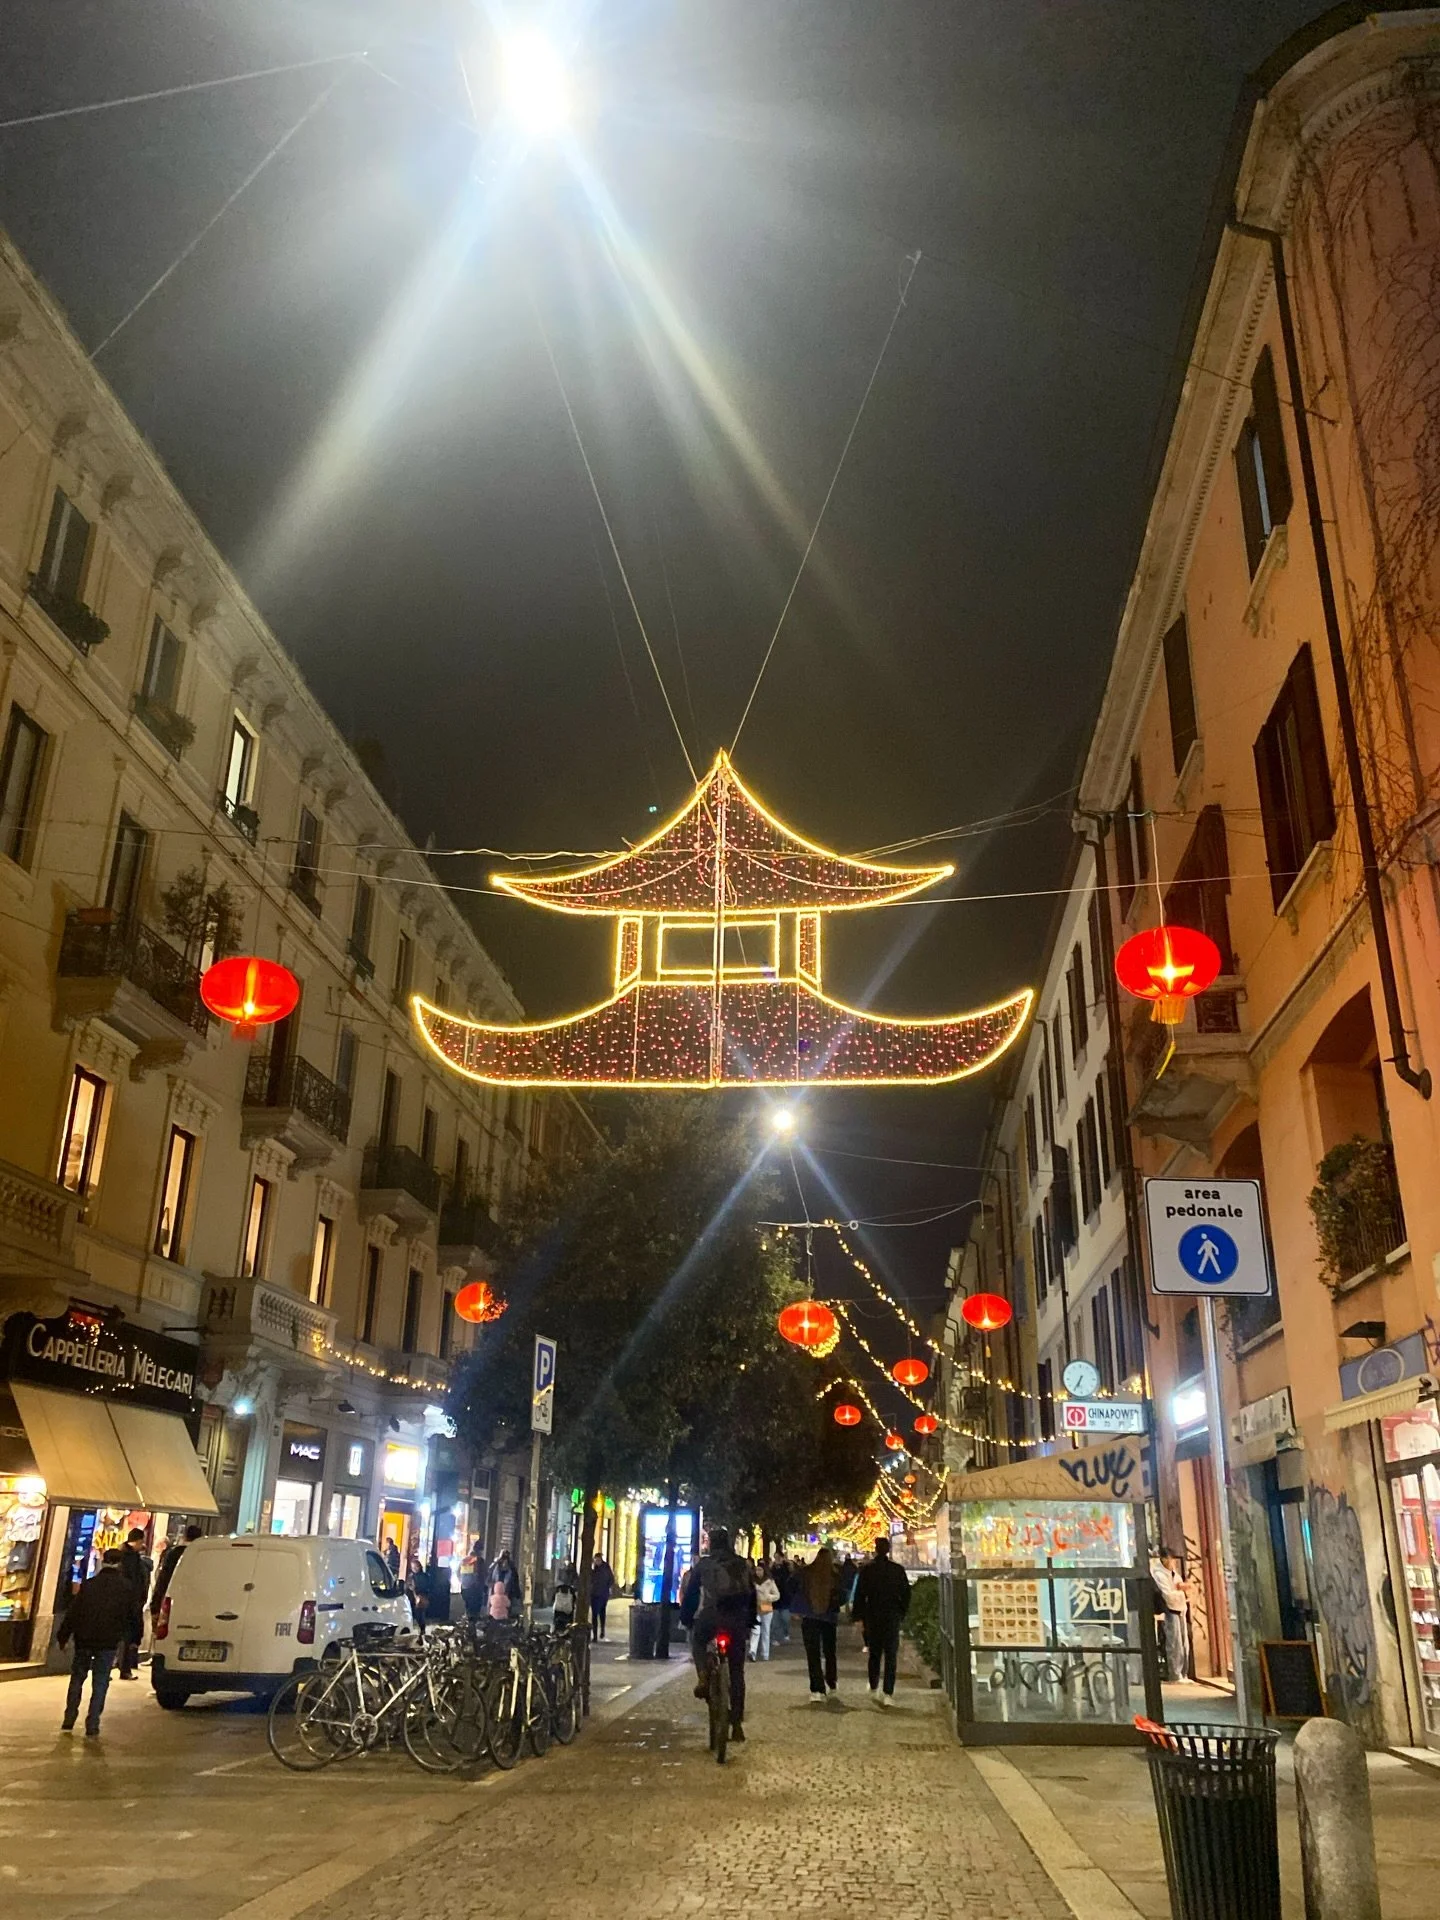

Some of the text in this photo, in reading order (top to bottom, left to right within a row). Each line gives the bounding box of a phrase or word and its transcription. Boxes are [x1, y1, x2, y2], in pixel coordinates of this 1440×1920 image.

[1184, 1189, 1221, 1200] area
[1166, 1204, 1243, 1218] pedonale
[26, 1323, 126, 1379] CAPPELLERIA
[540, 1350, 551, 1386] P
[275, 1622, 293, 1637] FIAT
